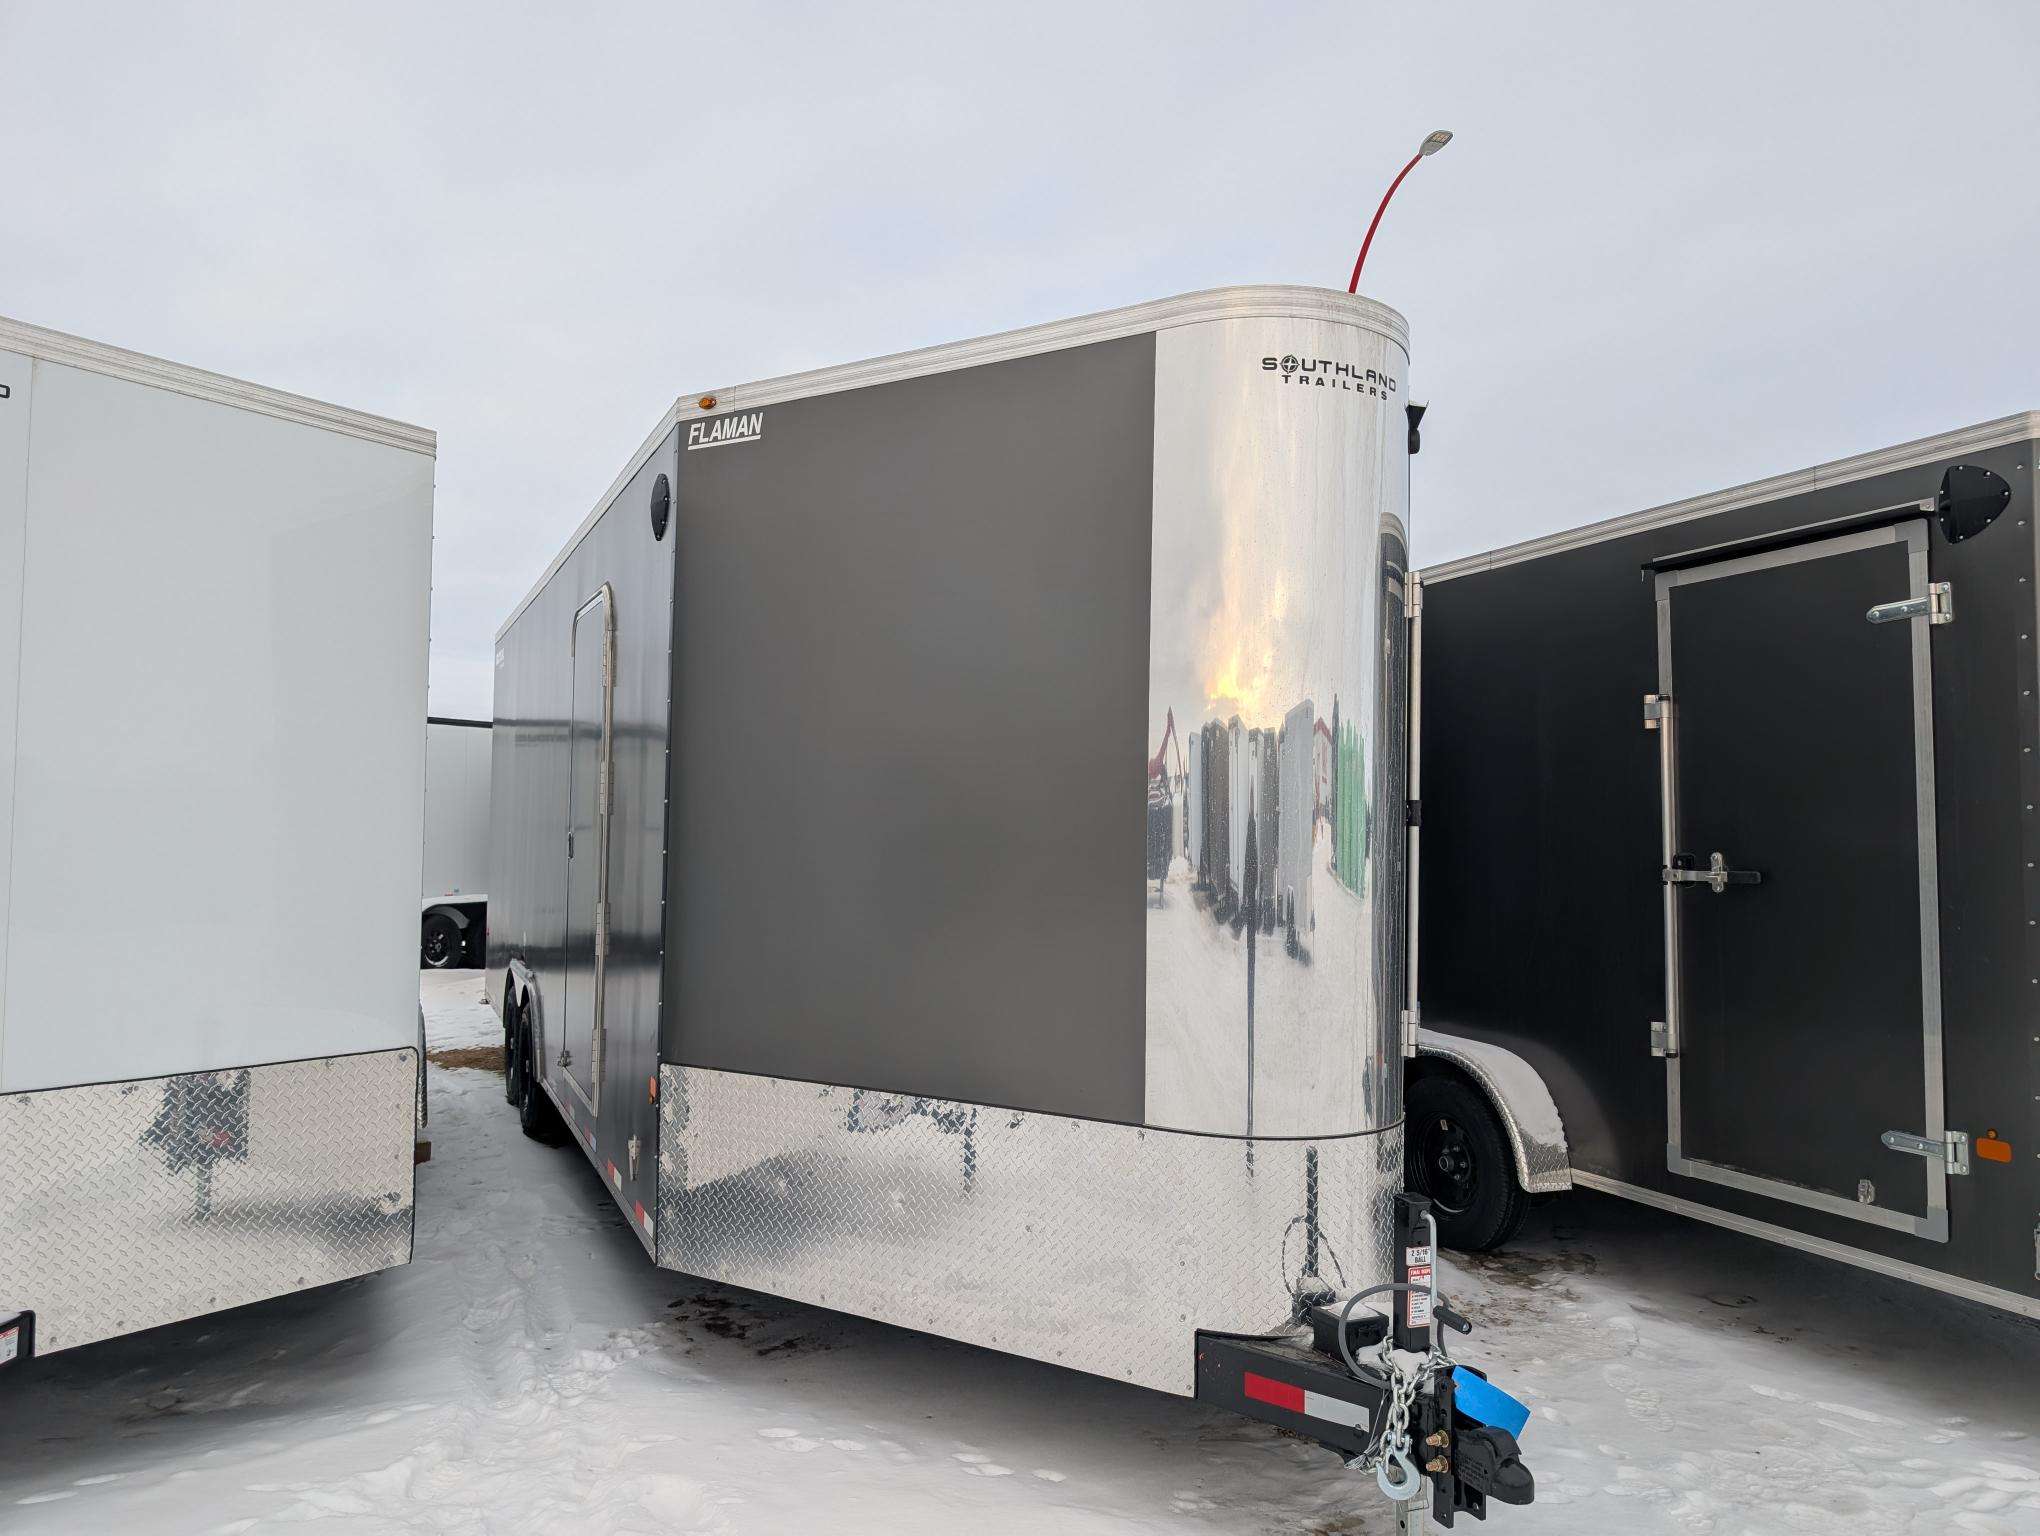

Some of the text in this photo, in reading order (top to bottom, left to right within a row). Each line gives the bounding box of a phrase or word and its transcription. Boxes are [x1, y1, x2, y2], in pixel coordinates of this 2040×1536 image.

[1261, 354, 1397, 393] SOUTHLAND
[1281, 374, 1388, 401] TRAILERS
[687, 412, 764, 446] FLAMAN
